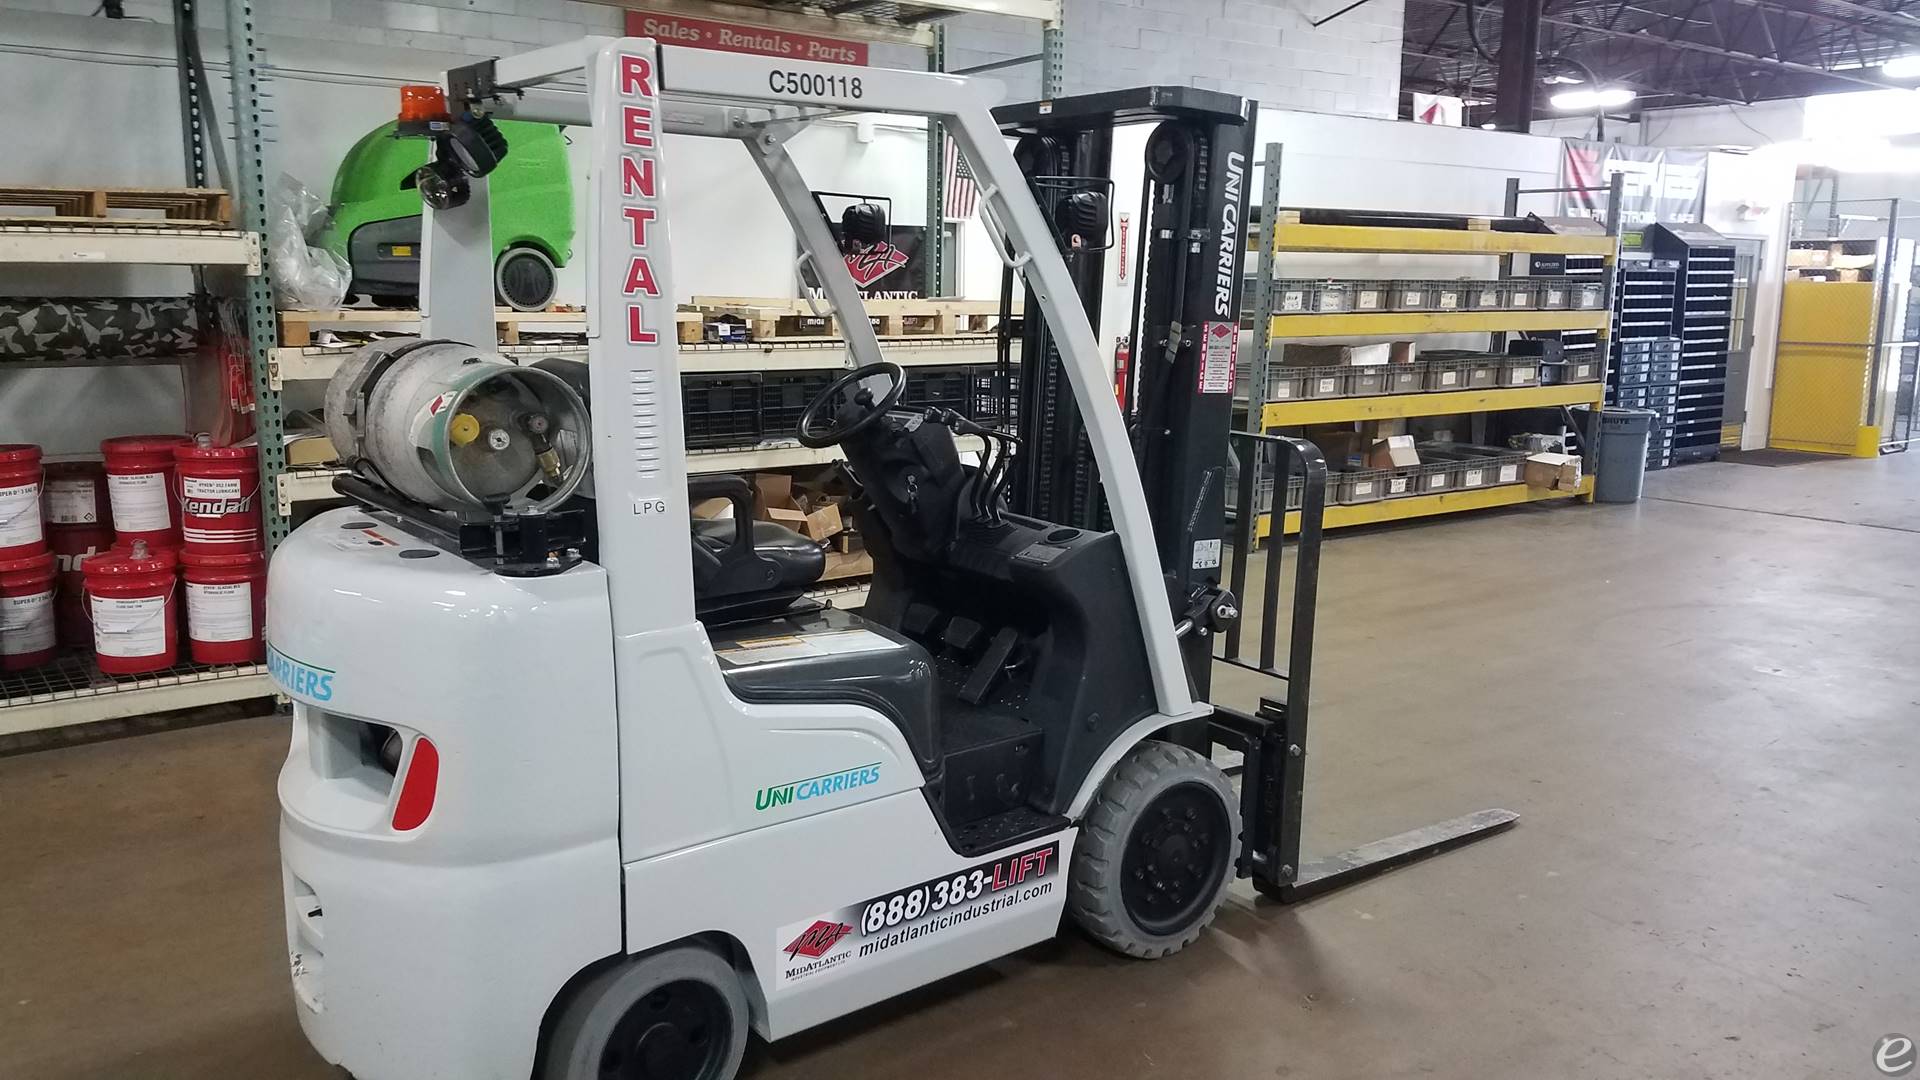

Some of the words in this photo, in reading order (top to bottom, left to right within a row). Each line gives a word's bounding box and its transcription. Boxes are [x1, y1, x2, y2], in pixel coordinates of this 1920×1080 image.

[643, 18, 700, 42] Sales
[719, 28, 792, 55] Rentals
[807, 41, 857, 62] Parts
[769, 69, 863, 99] C500118
[620, 53, 659, 344] RENTAL
[182, 497, 250, 514] Kendall
[633, 500, 665, 515] LPG
[858, 881, 1053, 958] midatlanticindustrial.com
